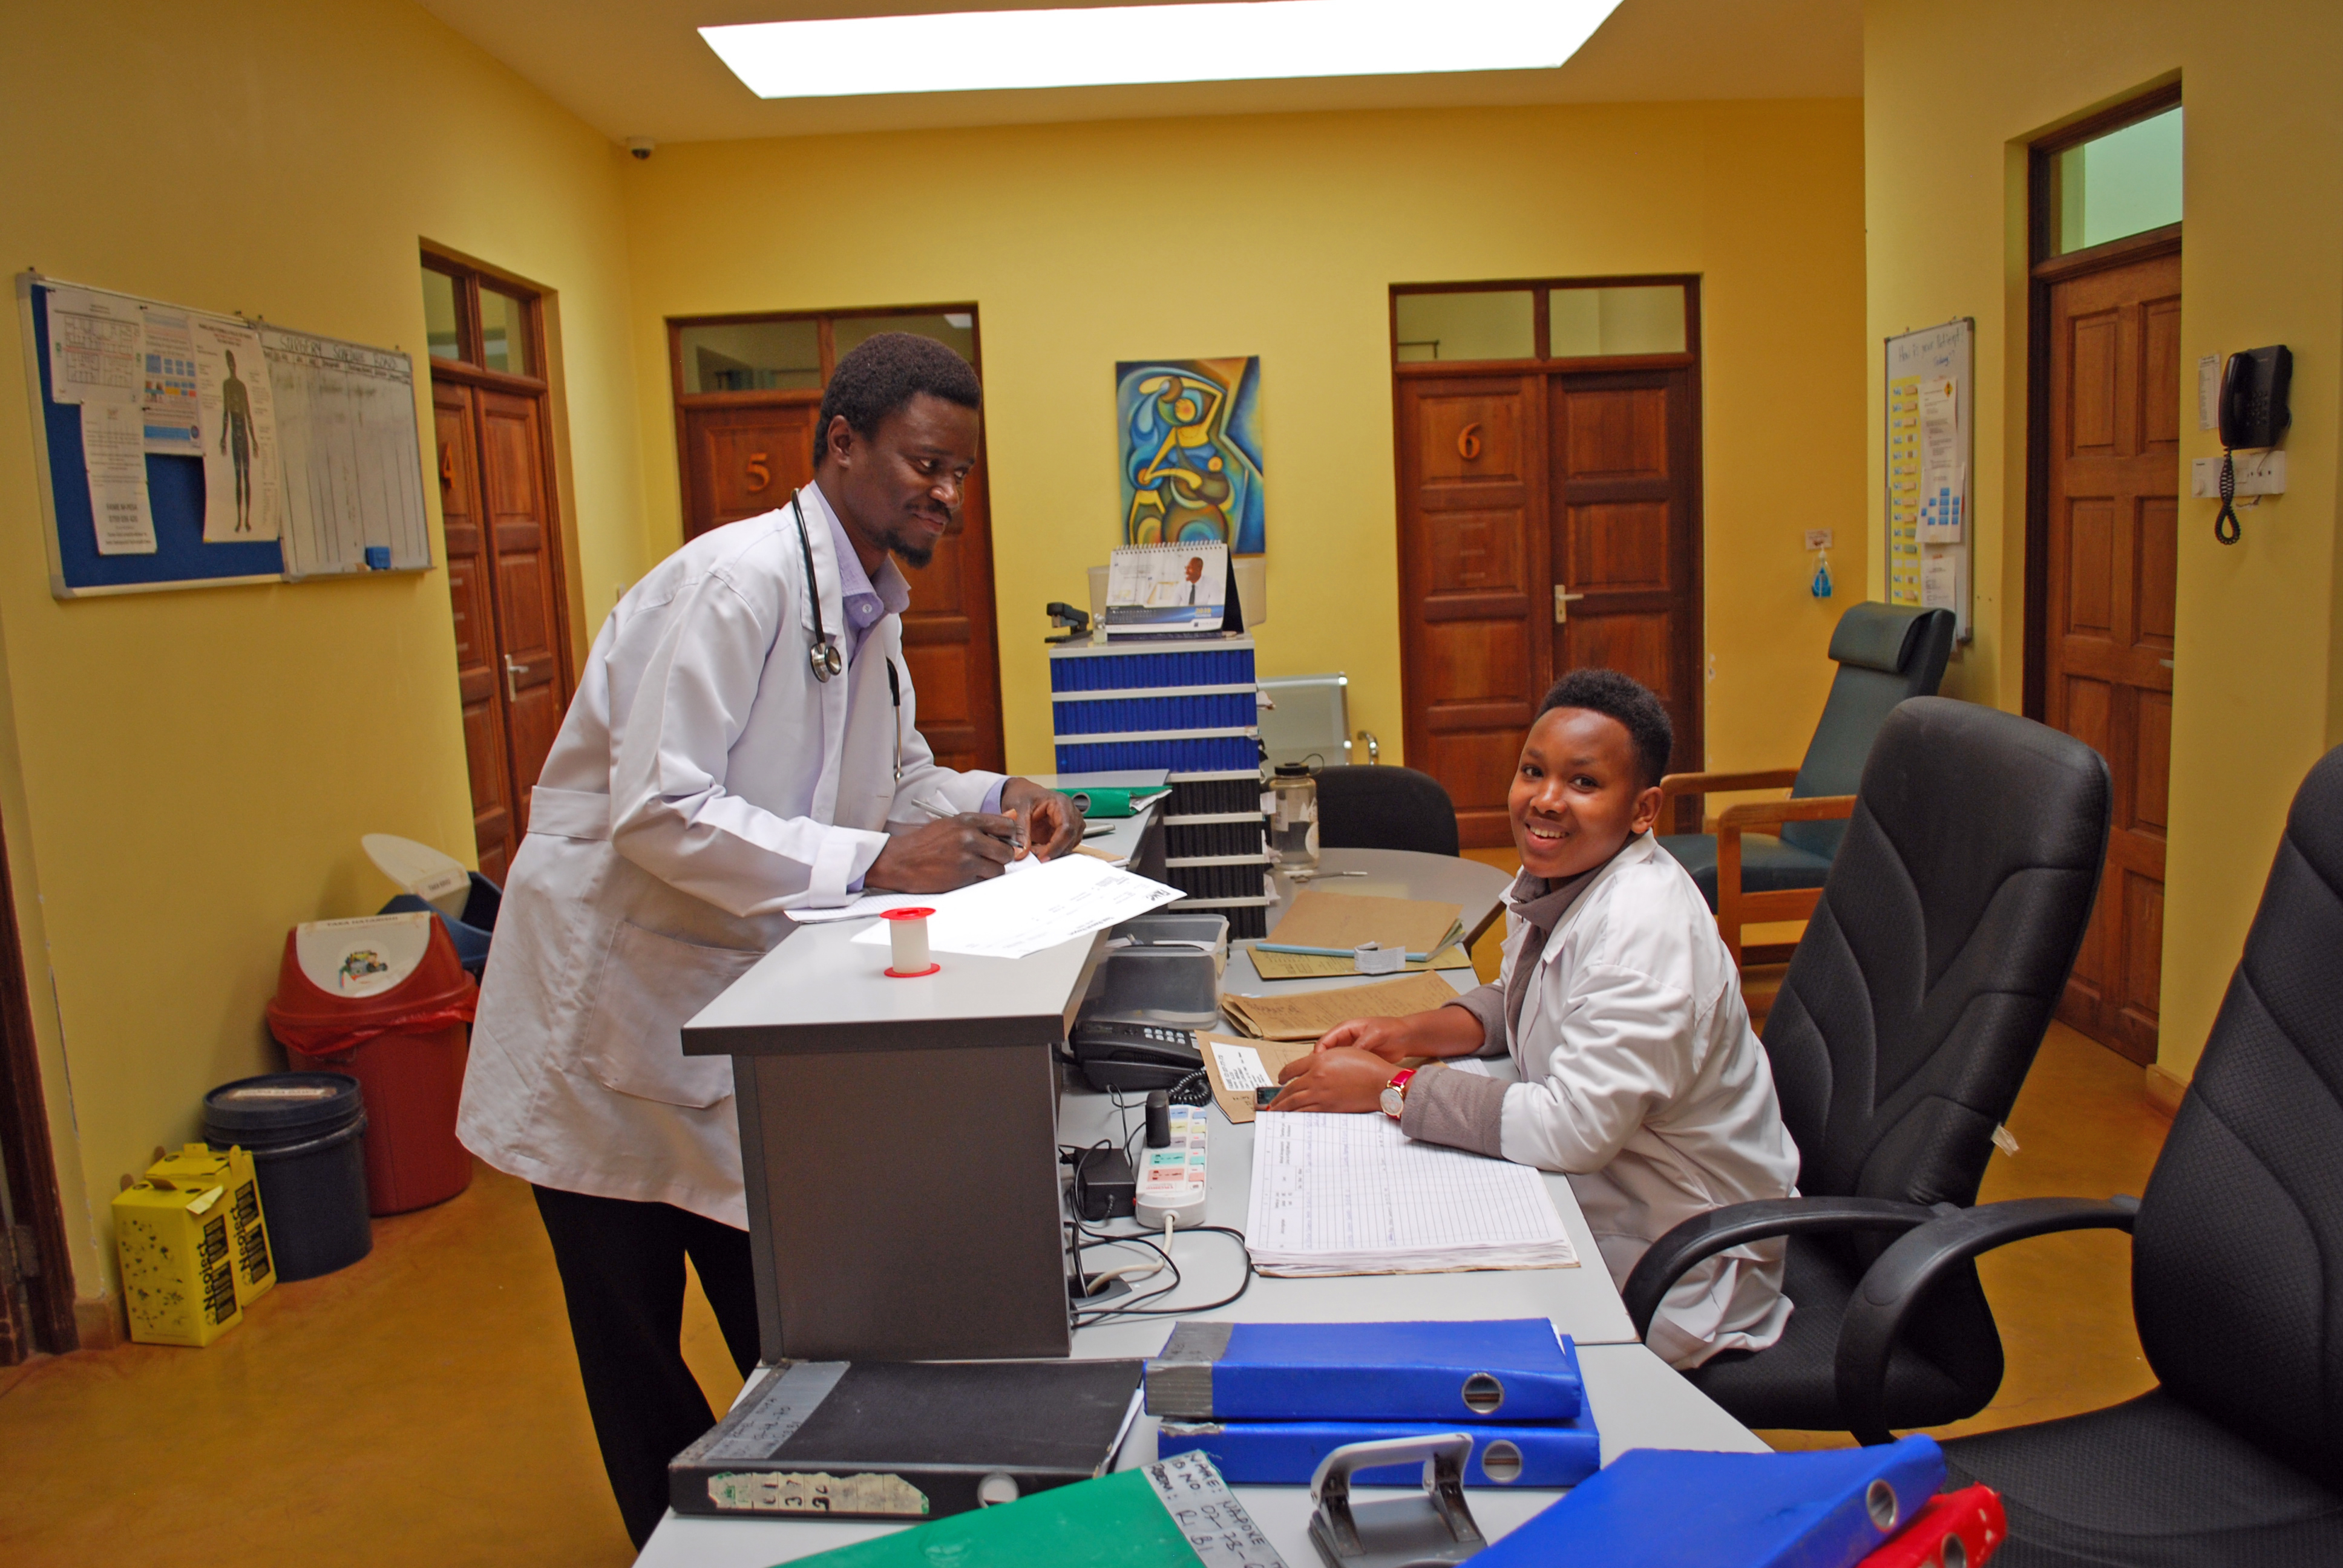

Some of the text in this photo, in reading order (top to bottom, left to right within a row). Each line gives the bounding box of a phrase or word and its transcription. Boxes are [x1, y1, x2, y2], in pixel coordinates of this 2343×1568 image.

[1458, 422, 1481, 459] 6
[443, 442, 456, 488] 4
[746, 452, 770, 491] 5
